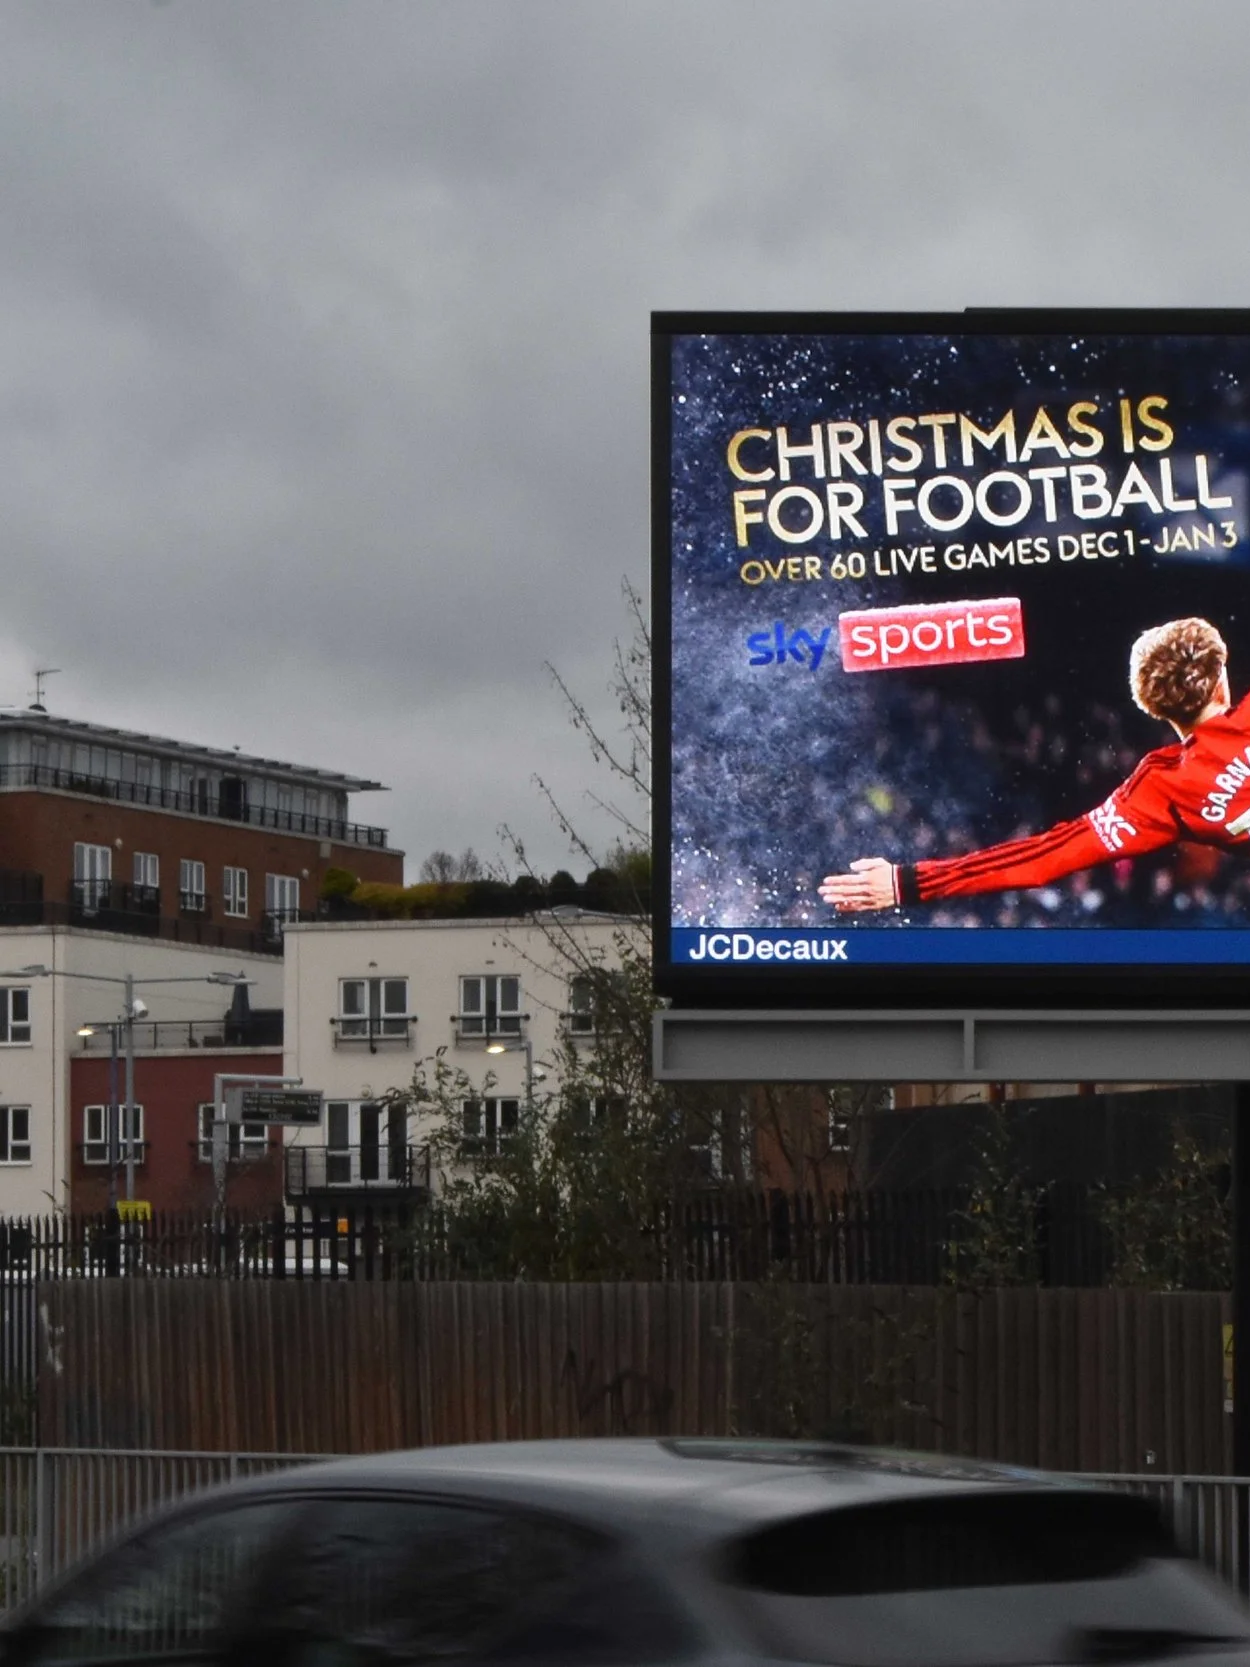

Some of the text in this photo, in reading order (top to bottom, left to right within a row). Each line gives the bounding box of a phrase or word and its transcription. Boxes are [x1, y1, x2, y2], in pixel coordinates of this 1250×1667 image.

[727, 395, 1174, 482] CHRISTMAS IS
[733, 455, 1233, 547] FOR FOOTBALL
[740, 556, 822, 585] OVER
[830, 552, 866, 580] 60
[874, 546, 937, 576] LIVE
[944, 537, 1050, 570] GAMES
[1057, 531, 1119, 562] DEC
[1221, 521, 1238, 549] 3
[746, 611, 1014, 672] sky sports
[689, 934, 848, 960] JCDecaux
